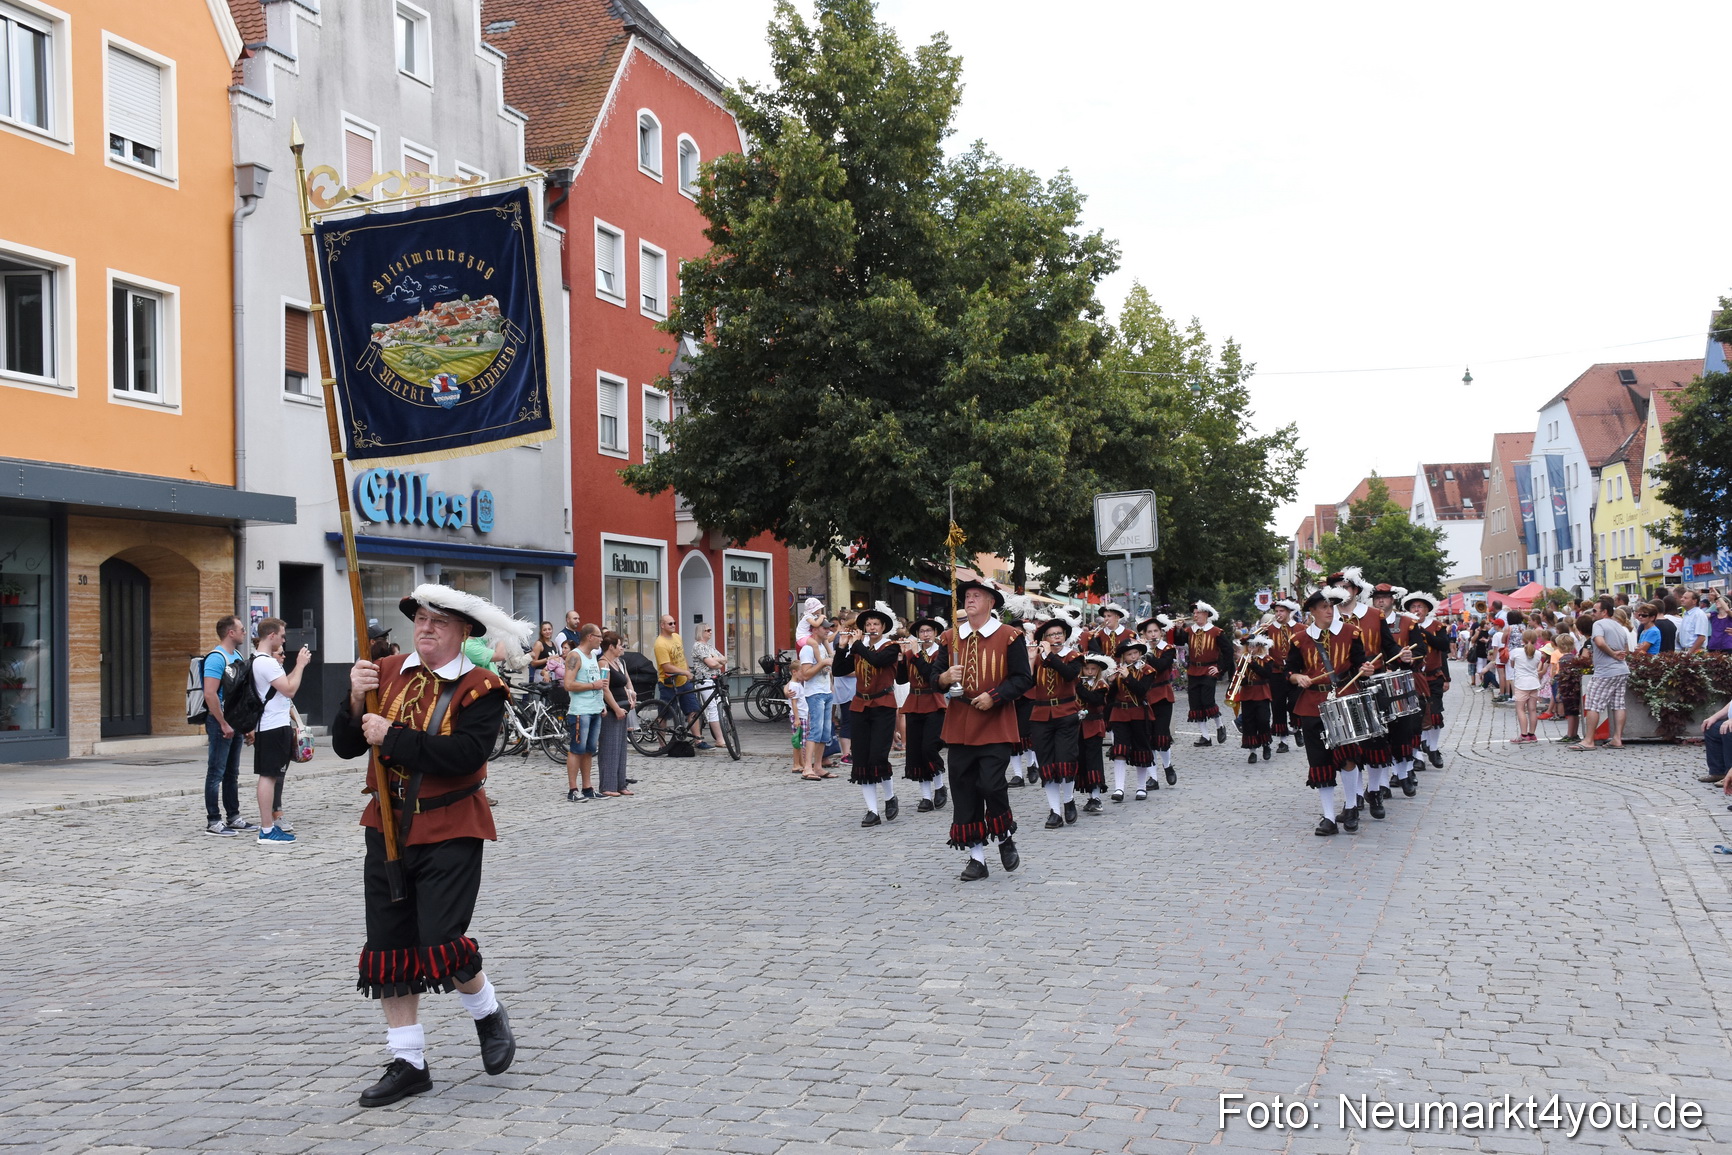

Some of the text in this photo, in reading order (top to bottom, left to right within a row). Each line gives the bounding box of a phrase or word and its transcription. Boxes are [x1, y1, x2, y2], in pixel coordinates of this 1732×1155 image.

[372, 249, 495, 294] Spielmannszug
[379, 346, 515, 402] Markt Lupburg
[354, 468, 469, 530] Eilles
[1113, 535, 1141, 546] ZONE
[256, 560, 264, 570] 31
[612, 552, 649, 574] fielmann
[77, 574, 88, 586] 30
[730, 565, 758, 583] fielmann
